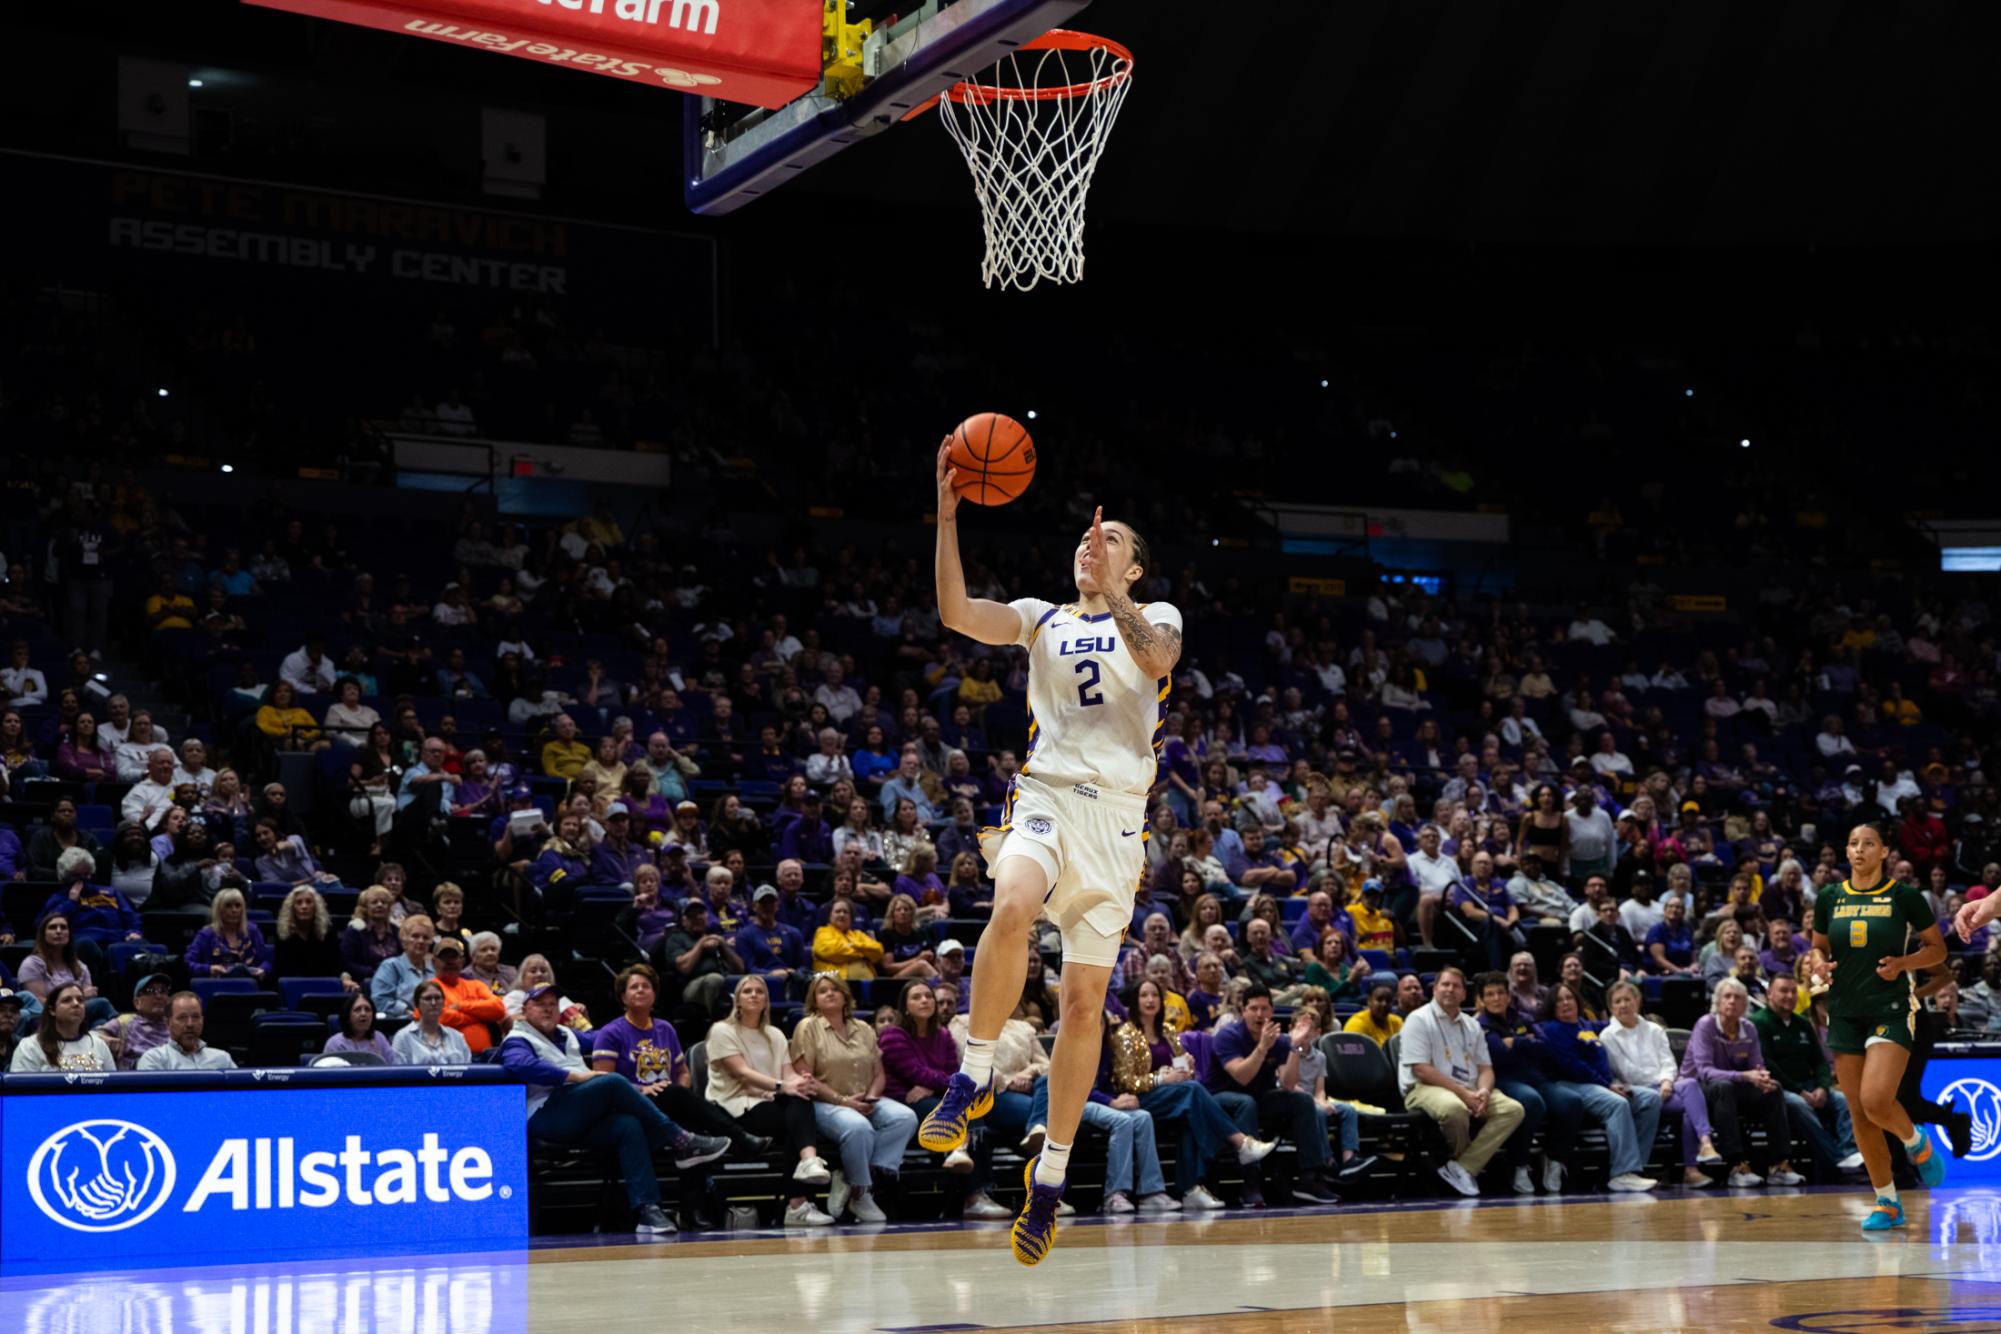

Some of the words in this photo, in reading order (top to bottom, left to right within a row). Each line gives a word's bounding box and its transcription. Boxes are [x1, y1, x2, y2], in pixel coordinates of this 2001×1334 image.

[535, 0, 720, 35] arm
[111, 171, 264, 222] PETE
[283, 189, 568, 255] MARAVICH
[109, 216, 376, 273] ASSEMBLY
[392, 249, 567, 295] CENTER
[1060, 637, 1116, 656] LSU
[1075, 659, 1104, 707] 2
[182, 1132, 494, 1212] Allstate
